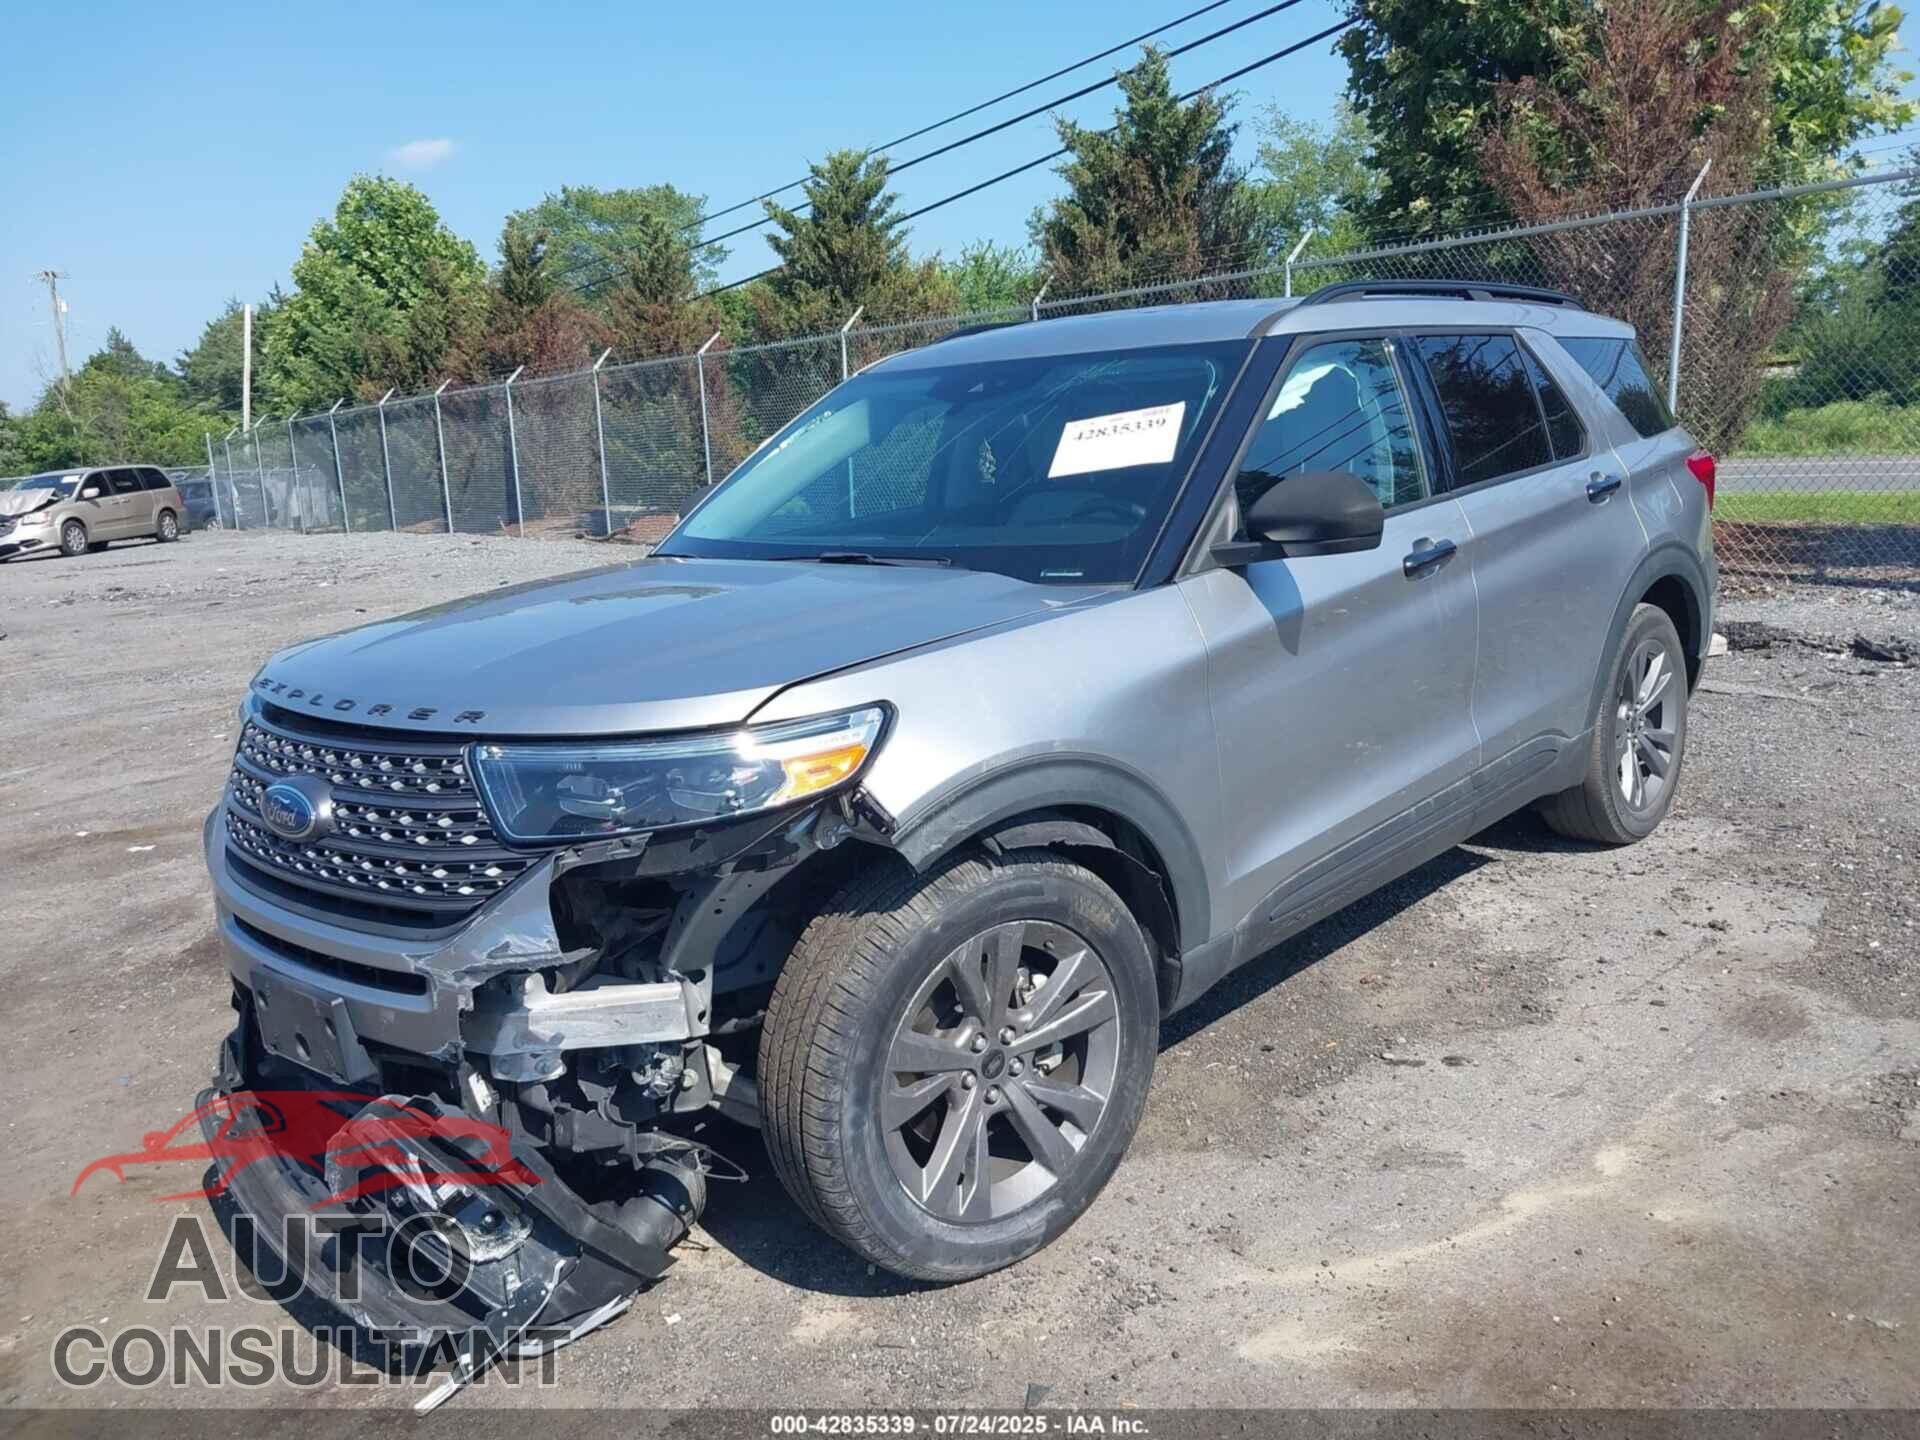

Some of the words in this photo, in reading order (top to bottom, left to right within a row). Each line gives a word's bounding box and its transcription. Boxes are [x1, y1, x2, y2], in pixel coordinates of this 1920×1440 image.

[1072, 418, 1167, 441] 42835339
[255, 677, 486, 725] EXPLORER
[267, 794, 299, 828] Ford
